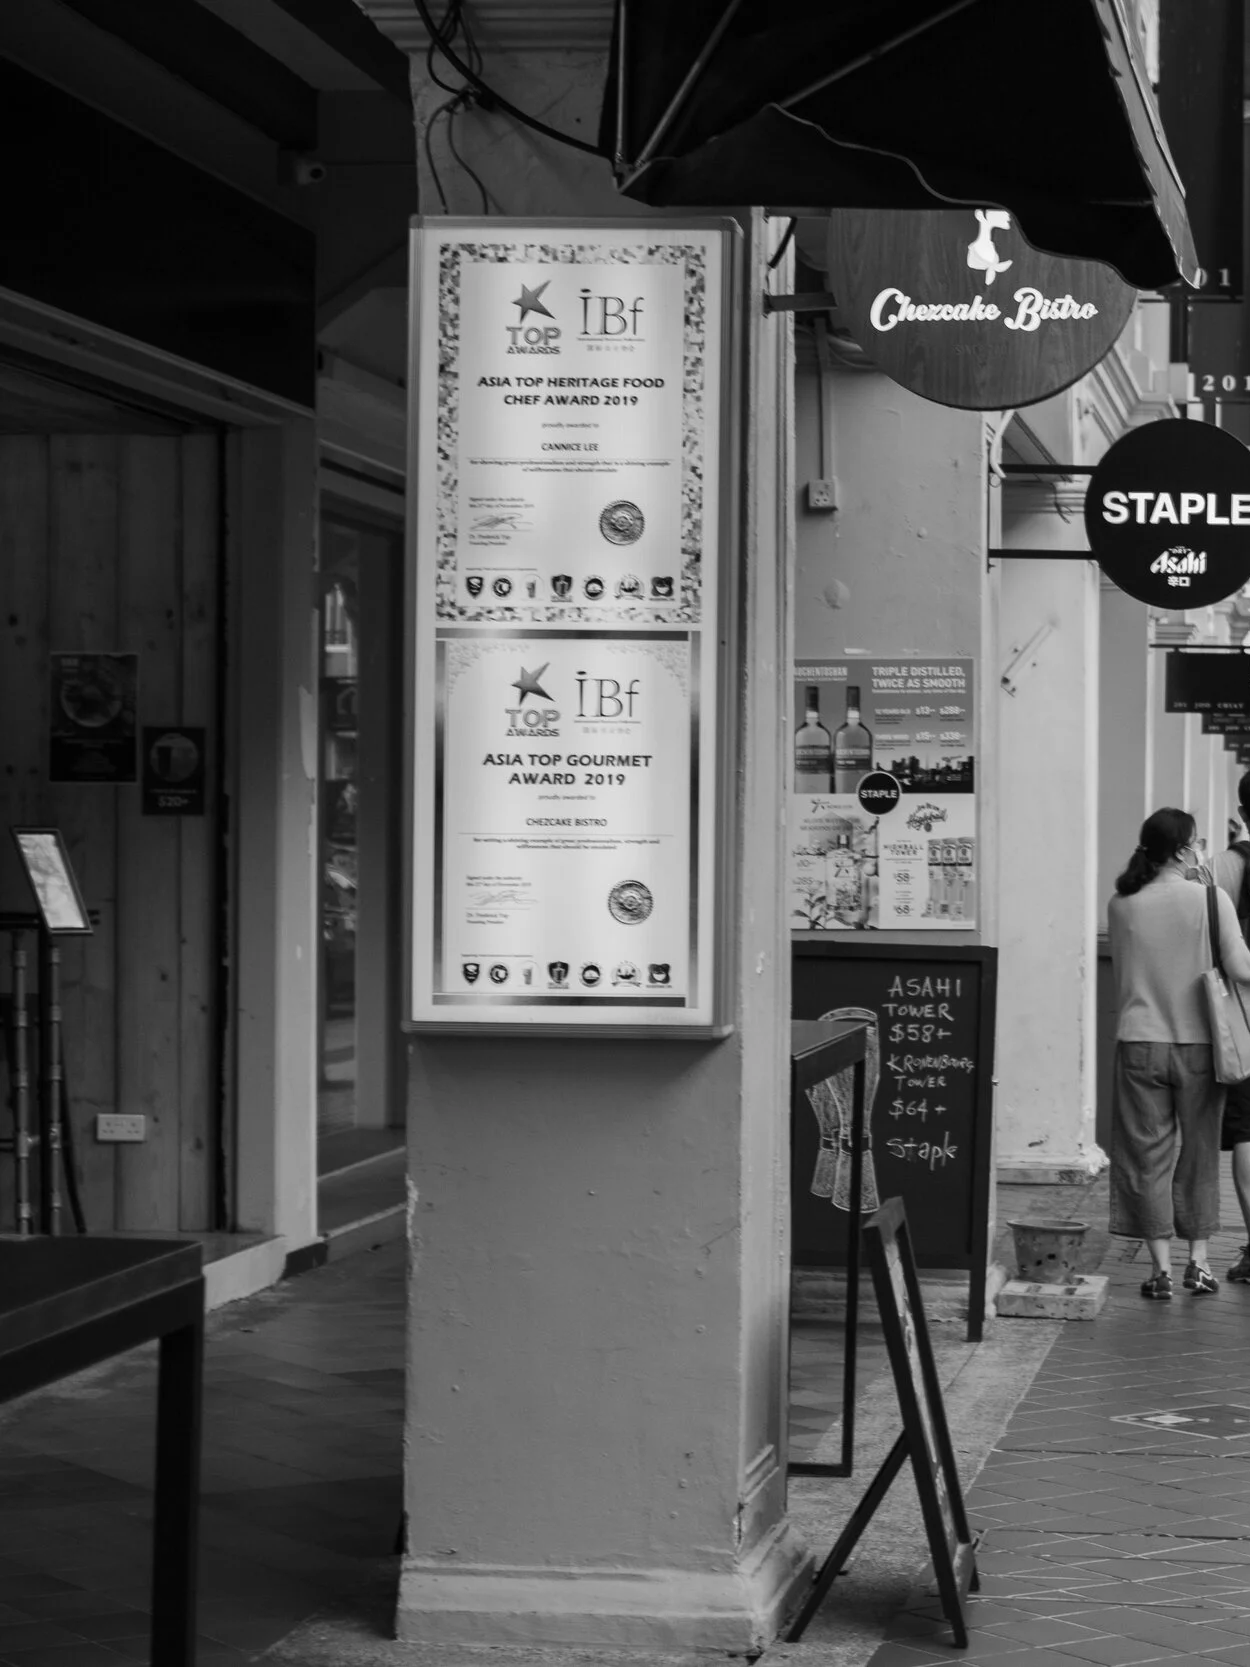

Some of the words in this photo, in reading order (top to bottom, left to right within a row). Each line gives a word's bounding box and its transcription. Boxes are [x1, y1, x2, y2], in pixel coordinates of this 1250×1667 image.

[870, 287, 1001, 332] Chezcake
[1004, 286, 1098, 332] Bistro
[506, 326, 561, 345] TOP
[506, 346, 561, 355] AWARDS
[477, 376, 511, 388] ASIA
[515, 377, 544, 388] TOP
[547, 377, 619, 389] HERITAGE
[623, 377, 665, 389] FOOD
[504, 394, 541, 406] CHEF
[544, 394, 600, 406] AWARD
[604, 395, 639, 406] 2019
[584, 443, 600, 452] LEE
[1149, 550, 1208, 574] Asahi
[872, 666, 908, 676] TRIPLE
[872, 678, 904, 688] TWICE
[907, 678, 921, 688] AS
[922, 678, 966, 688] SMOOTH
[505, 708, 561, 728] TOP
[505, 728, 560, 737] AWARDS
[483, 753, 523, 767] ASIA
[528, 753, 562, 767] TOP
[566, 754, 653, 767] GOURMET
[508, 773, 576, 785] AWARD
[585, 773, 626, 786] 2019
[860, 789, 897, 798] STAPLE
[526, 817, 572, 827] CHEZCAKE
[575, 817, 608, 828] BISTRO
[888, 975, 962, 998] ASAHI
[882, 1003, 954, 1021] TOWER
[889, 1024, 952, 1043] $58+
[893, 1075, 947, 1091] TOWER
[886, 1131, 958, 1171] Staple
